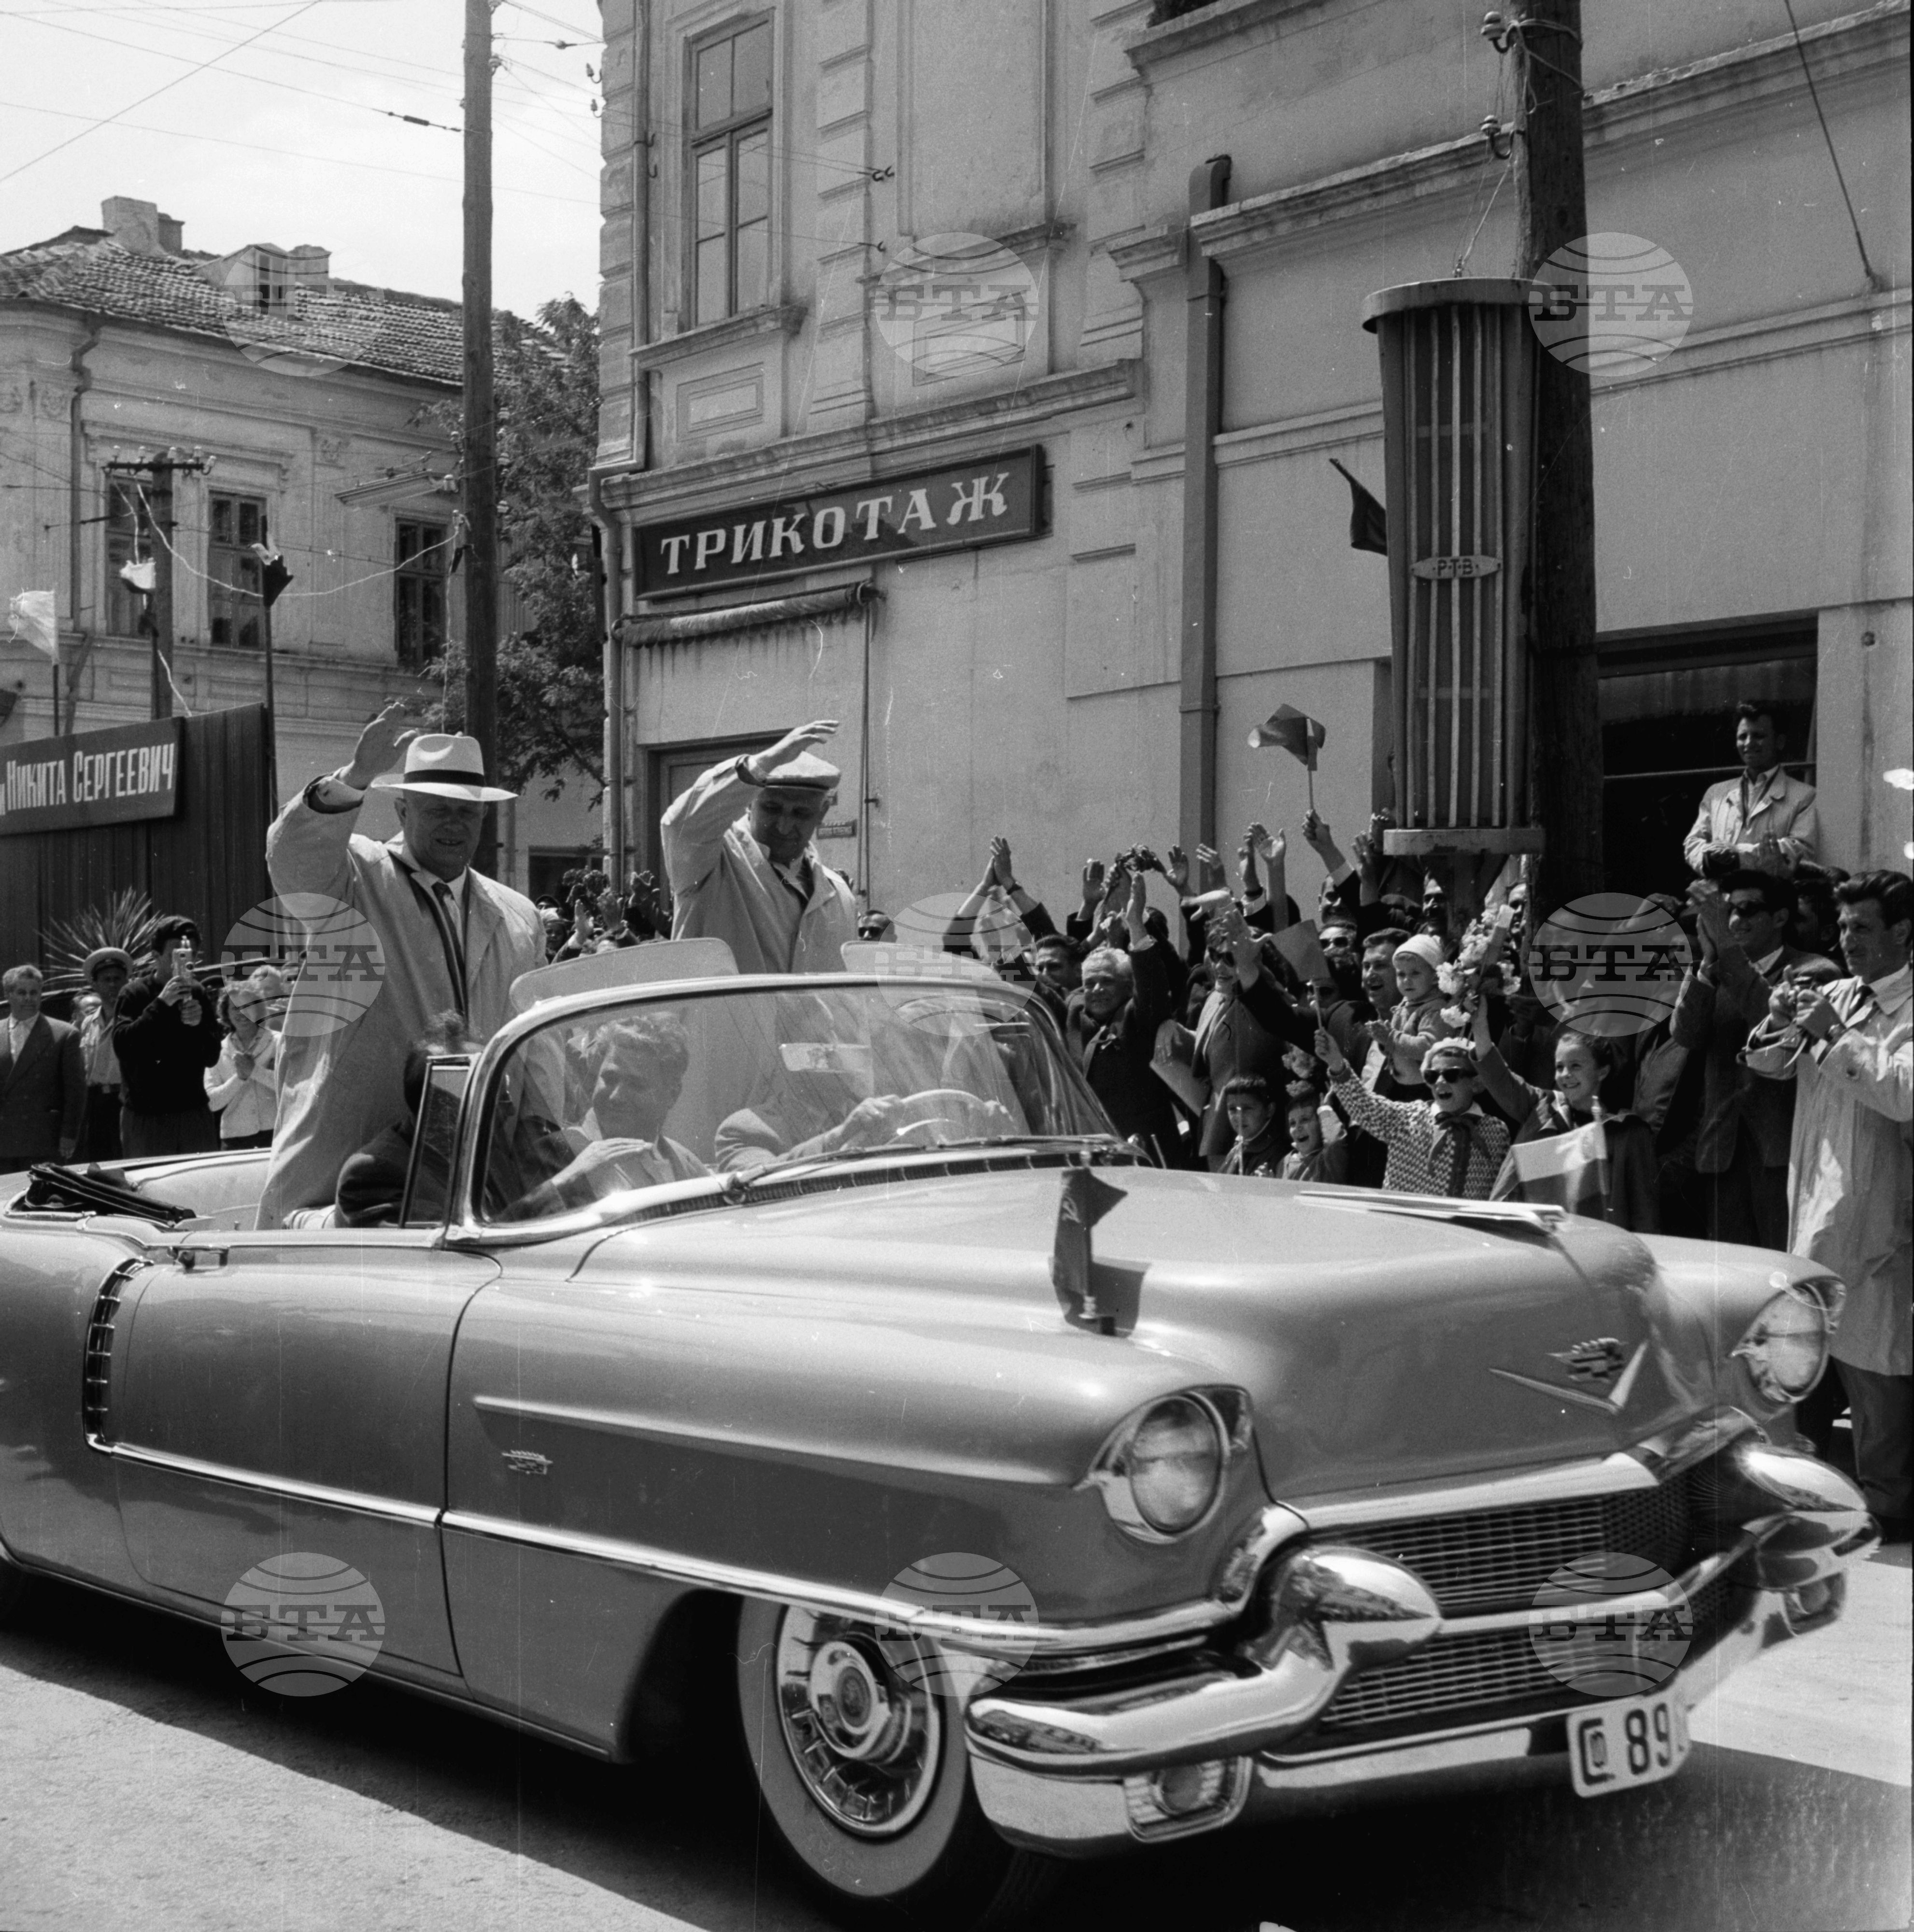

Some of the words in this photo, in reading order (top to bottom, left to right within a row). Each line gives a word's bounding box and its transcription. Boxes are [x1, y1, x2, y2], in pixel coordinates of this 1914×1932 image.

[660, 472, 1009, 574] ТРИКОТАЖ
[6, 760, 67, 811] НИКИТА
[73, 742, 175, 803] СЕРГЕЕВИЧ
[1625, 1694, 1686, 1776] 89
